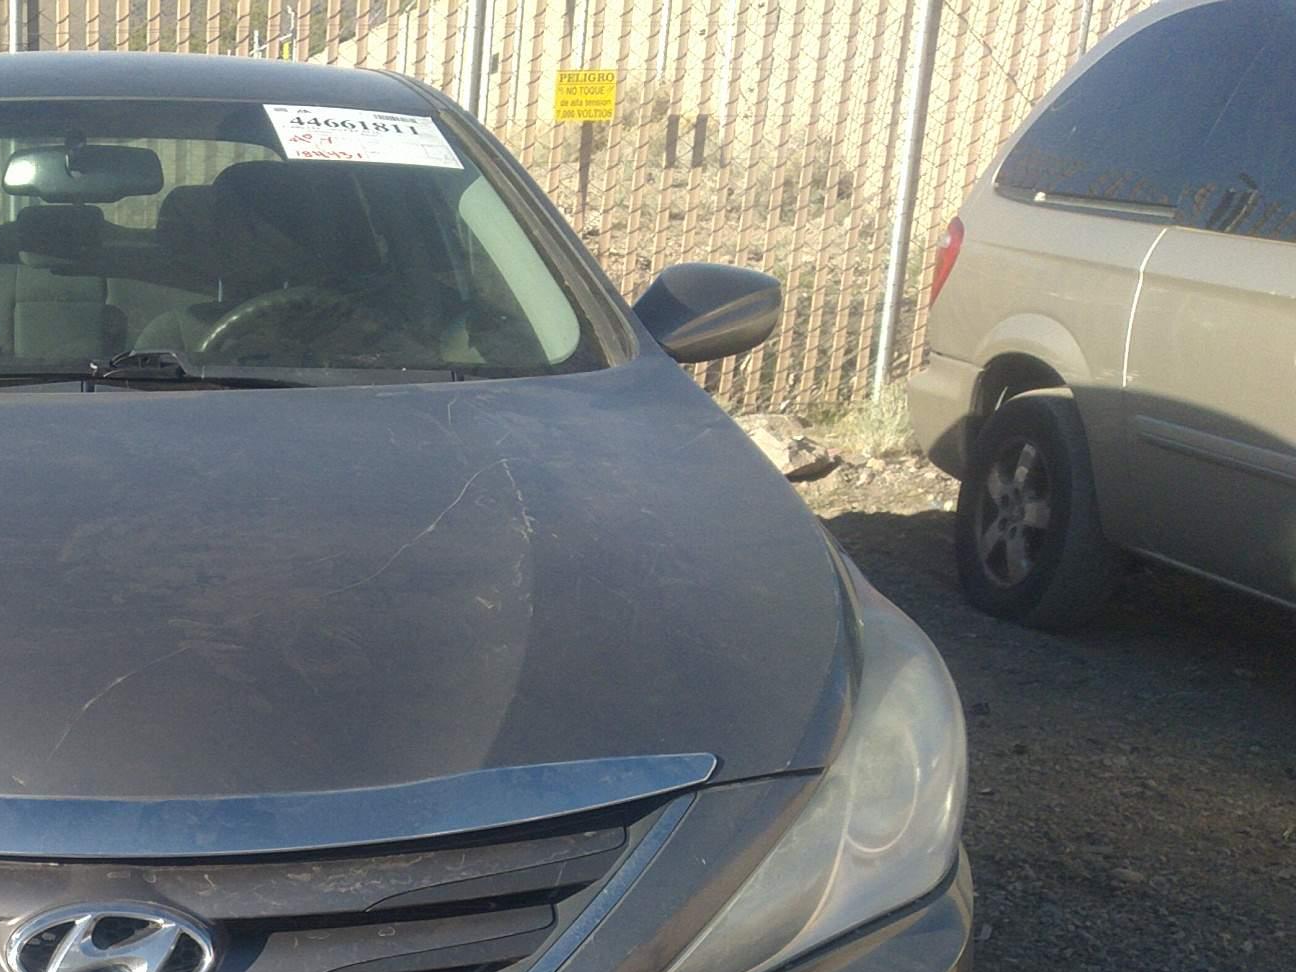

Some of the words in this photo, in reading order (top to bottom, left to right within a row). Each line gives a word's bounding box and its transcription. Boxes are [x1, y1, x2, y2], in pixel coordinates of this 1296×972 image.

[559, 73, 615, 82] PELIGRO
[567, 87, 577, 95] NO
[579, 87, 605, 95] TOQUE
[576, 108, 613, 118] VOLTIOS
[289, 116, 419, 135] 44661811
